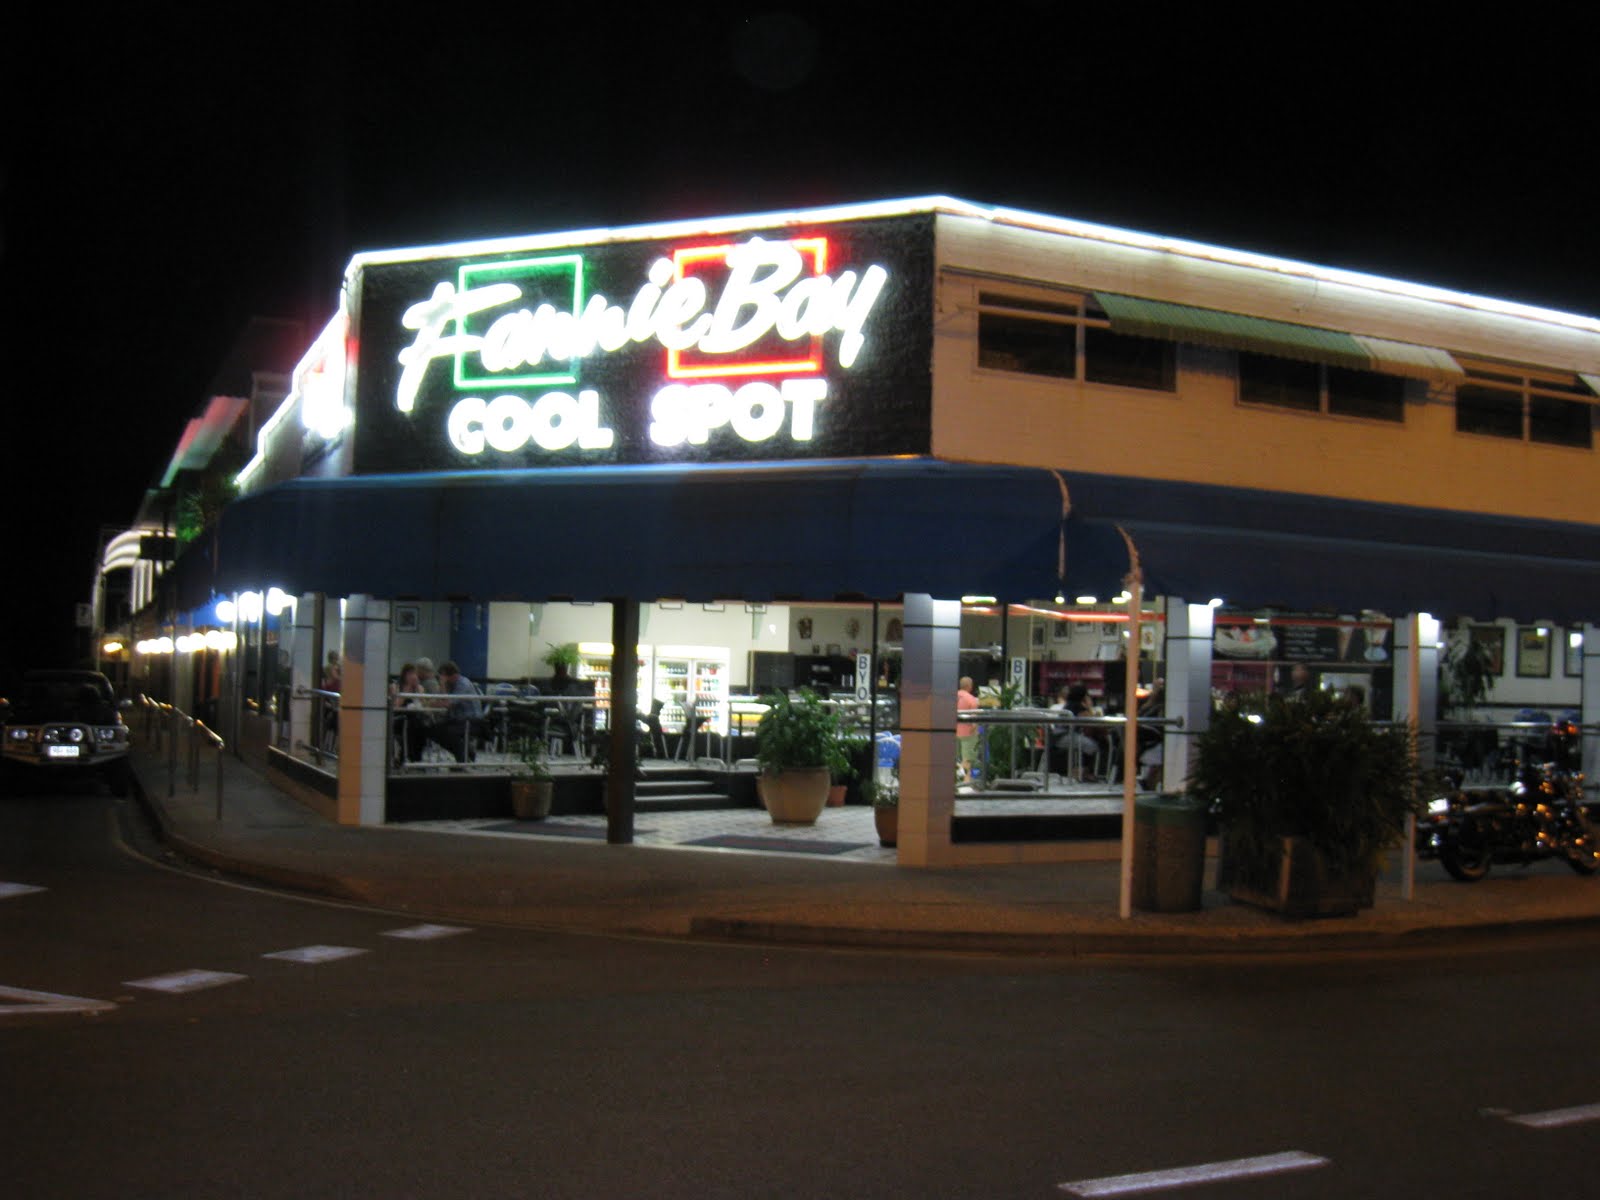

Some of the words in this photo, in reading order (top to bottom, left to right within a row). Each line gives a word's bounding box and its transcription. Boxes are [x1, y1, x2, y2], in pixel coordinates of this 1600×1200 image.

[448, 390, 613, 453] COOL
[650, 379, 827, 446] SPOT
[857, 657, 868, 701] BYO
